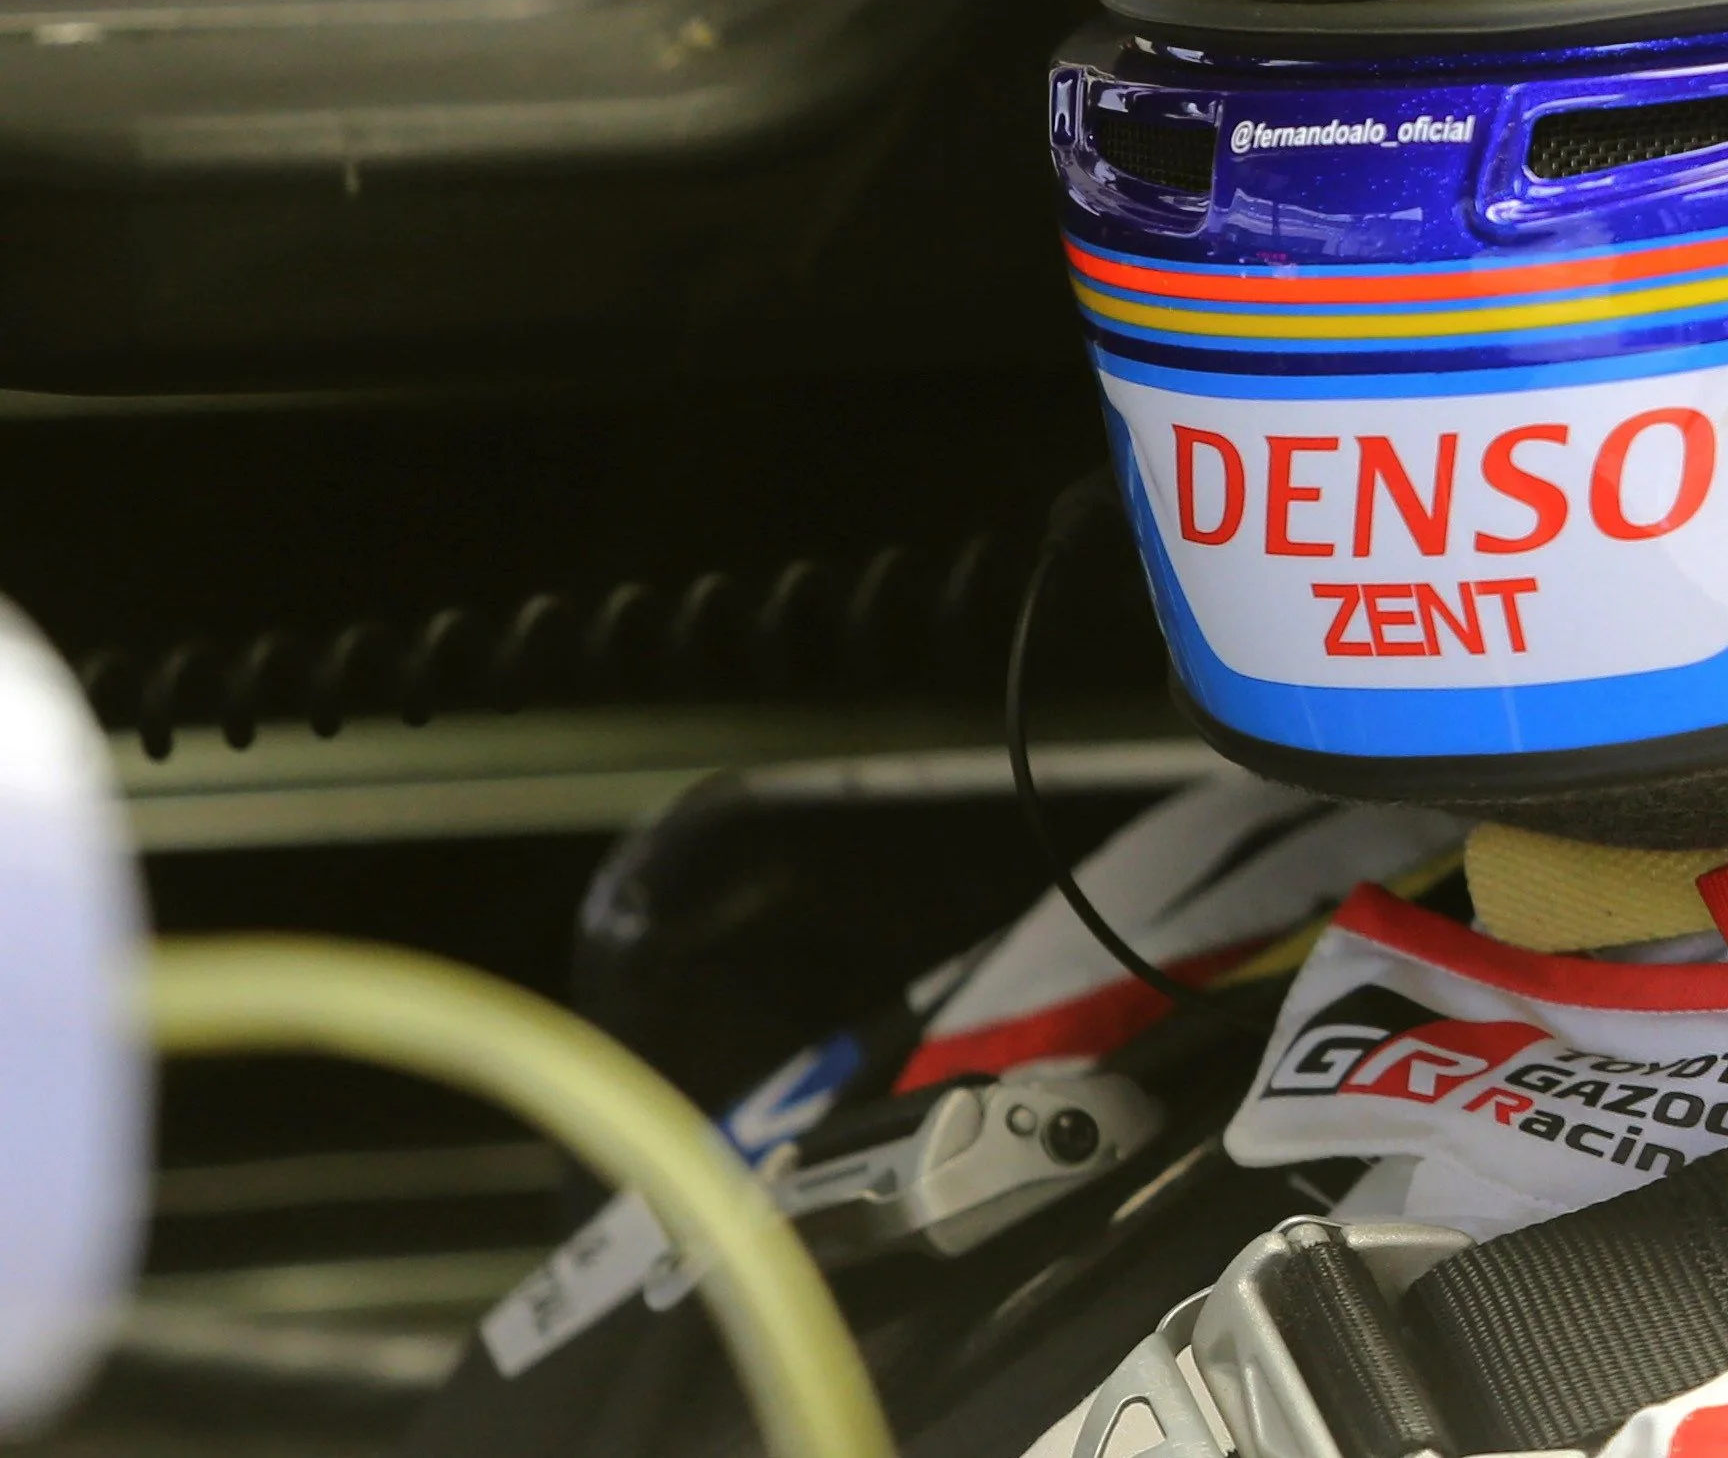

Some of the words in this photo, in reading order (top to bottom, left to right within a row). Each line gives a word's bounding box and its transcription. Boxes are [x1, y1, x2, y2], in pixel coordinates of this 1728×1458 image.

[1230, 114, 1476, 155] @fernandoalo_oficial
[1172, 406, 1718, 558] DENSO
[1311, 576, 1540, 658] ZENT
[1463, 1087, 1686, 1177] Racin
